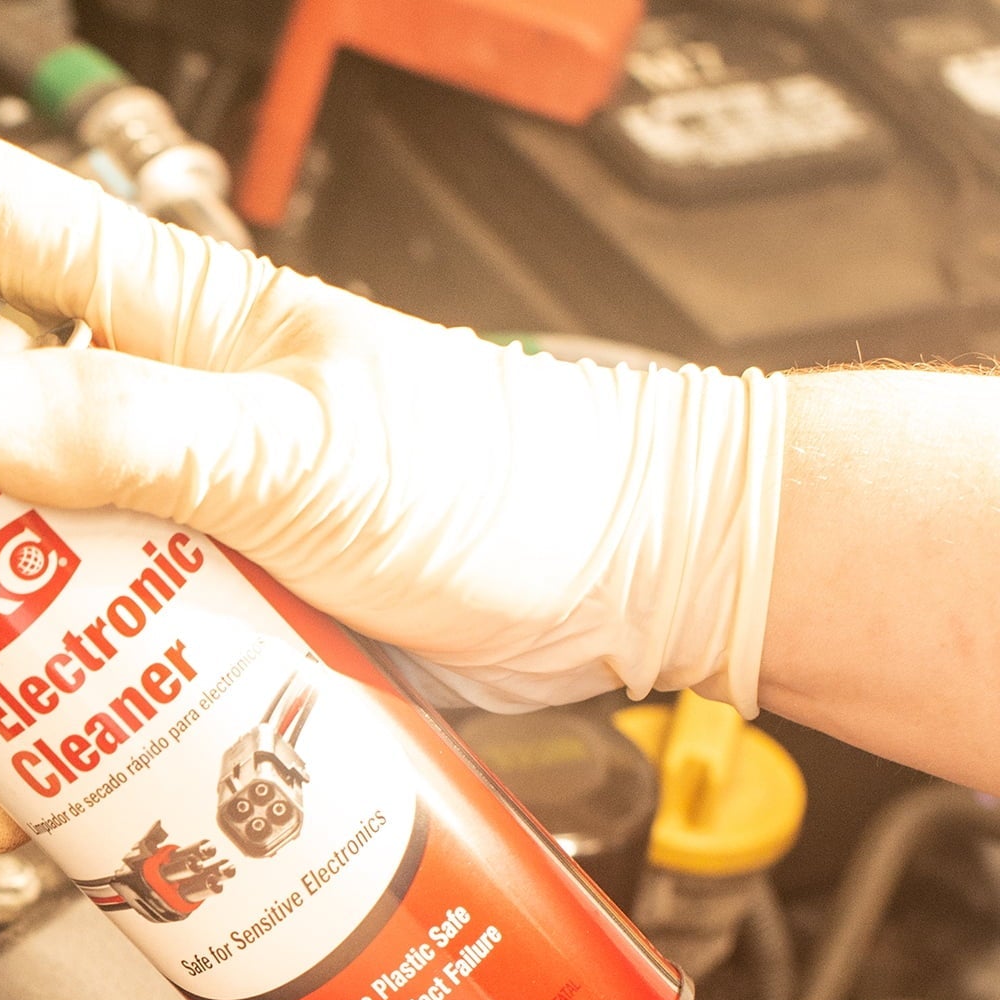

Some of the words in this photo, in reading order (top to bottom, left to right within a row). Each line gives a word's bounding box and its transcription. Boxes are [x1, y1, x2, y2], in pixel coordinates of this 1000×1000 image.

[11, 639, 198, 798] Cleaner
[26, 808, 70, 836] Limpiador
[68, 801, 85, 818] de
[87, 771, 128, 808] secado
[127, 736, 169, 775] rápido
[168, 708, 200, 743] para
[180, 953, 213, 977] Safe
[208, 943, 233, 964] for
[230, 891, 304, 950] Sensitive
[300, 810, 387, 896] Electronics
[370, 943, 436, 1000] Plastic
[428, 906, 471, 948] Safe
[442, 925, 502, 986] Failure
